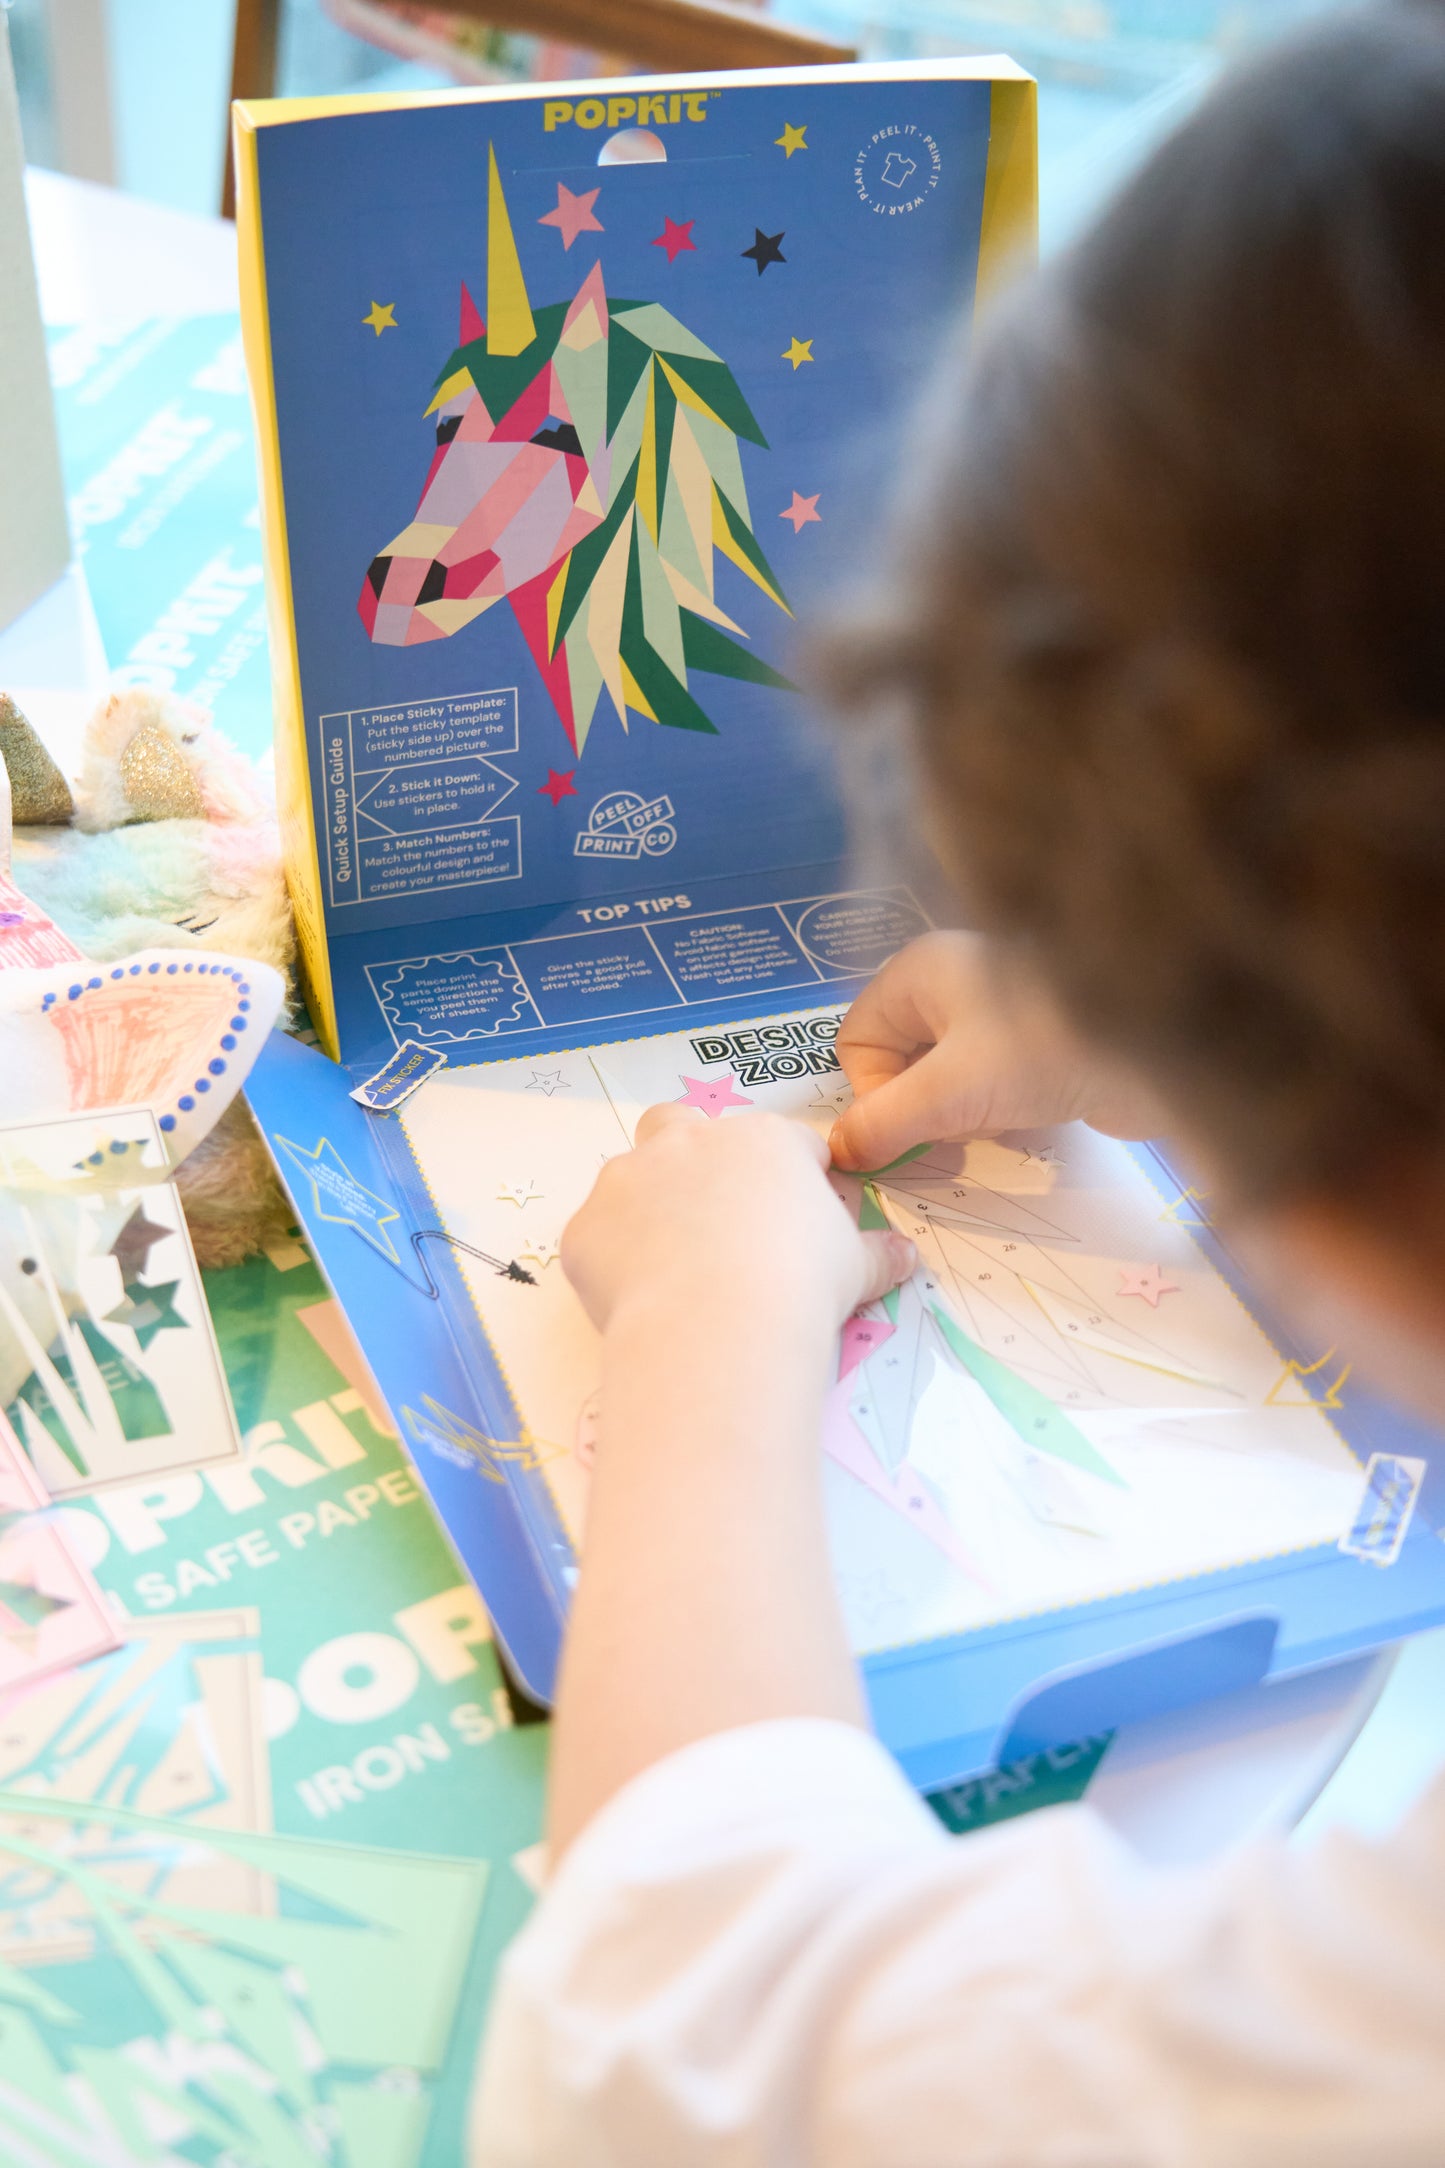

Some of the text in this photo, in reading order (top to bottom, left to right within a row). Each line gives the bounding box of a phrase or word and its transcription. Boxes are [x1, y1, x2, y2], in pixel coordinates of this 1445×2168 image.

[872, 125, 917, 144] PEEL IT
[923, 135, 941, 188] PRINT IT
[854, 151, 869, 200] PLAN IT
[873, 196, 924, 215] WEAR IT
[361, 698, 506, 726] 1. Place Sticky Template:
[368, 711, 501, 738] Put the sticky template
[365, 724, 504, 753] (sticky side up) over the
[384, 739, 489, 763] numbered picture.
[374, 783, 496, 809] Use stickers to hold it
[388, 773, 481, 794] 2. Stick it Down:
[329, 738, 352, 883] Quick Setup Guide
[414, 802, 460, 816] in place.
[595, 799, 663, 827] PEEL OFF
[364, 838, 510, 867] Match the numbers to the
[383, 828, 491, 852] 3. Match Numbers:
[582, 832, 670, 853] PRINT CO
[370, 863, 510, 892] create your masterpiece!
[382, 852, 494, 878] colourful design and
[577, 895, 692, 923] TOP TIPS
[540, 972, 580, 983] canvas
[595, 964, 623, 975] good
[625, 959, 646, 970] pull
[547, 955, 629, 973] Give the sticky
[401, 978, 500, 999] parts down in the
[415, 973, 477, 987] Place print
[542, 968, 652, 991] after the design has
[403, 998, 435, 1007] same
[437, 988, 488, 1002] direction
[416, 996, 498, 1015] you peel them
[429, 1006, 490, 1021] off sheets.
[689, 1013, 847, 1064] DESIG
[377, 1053, 425, 1095] FIX STICKER
[730, 1045, 843, 1087] ZON
[914, 1226, 928, 1235] 12
[133, 1466, 422, 1609] SAFE PAPE
[294, 1721, 451, 1820] IRON
